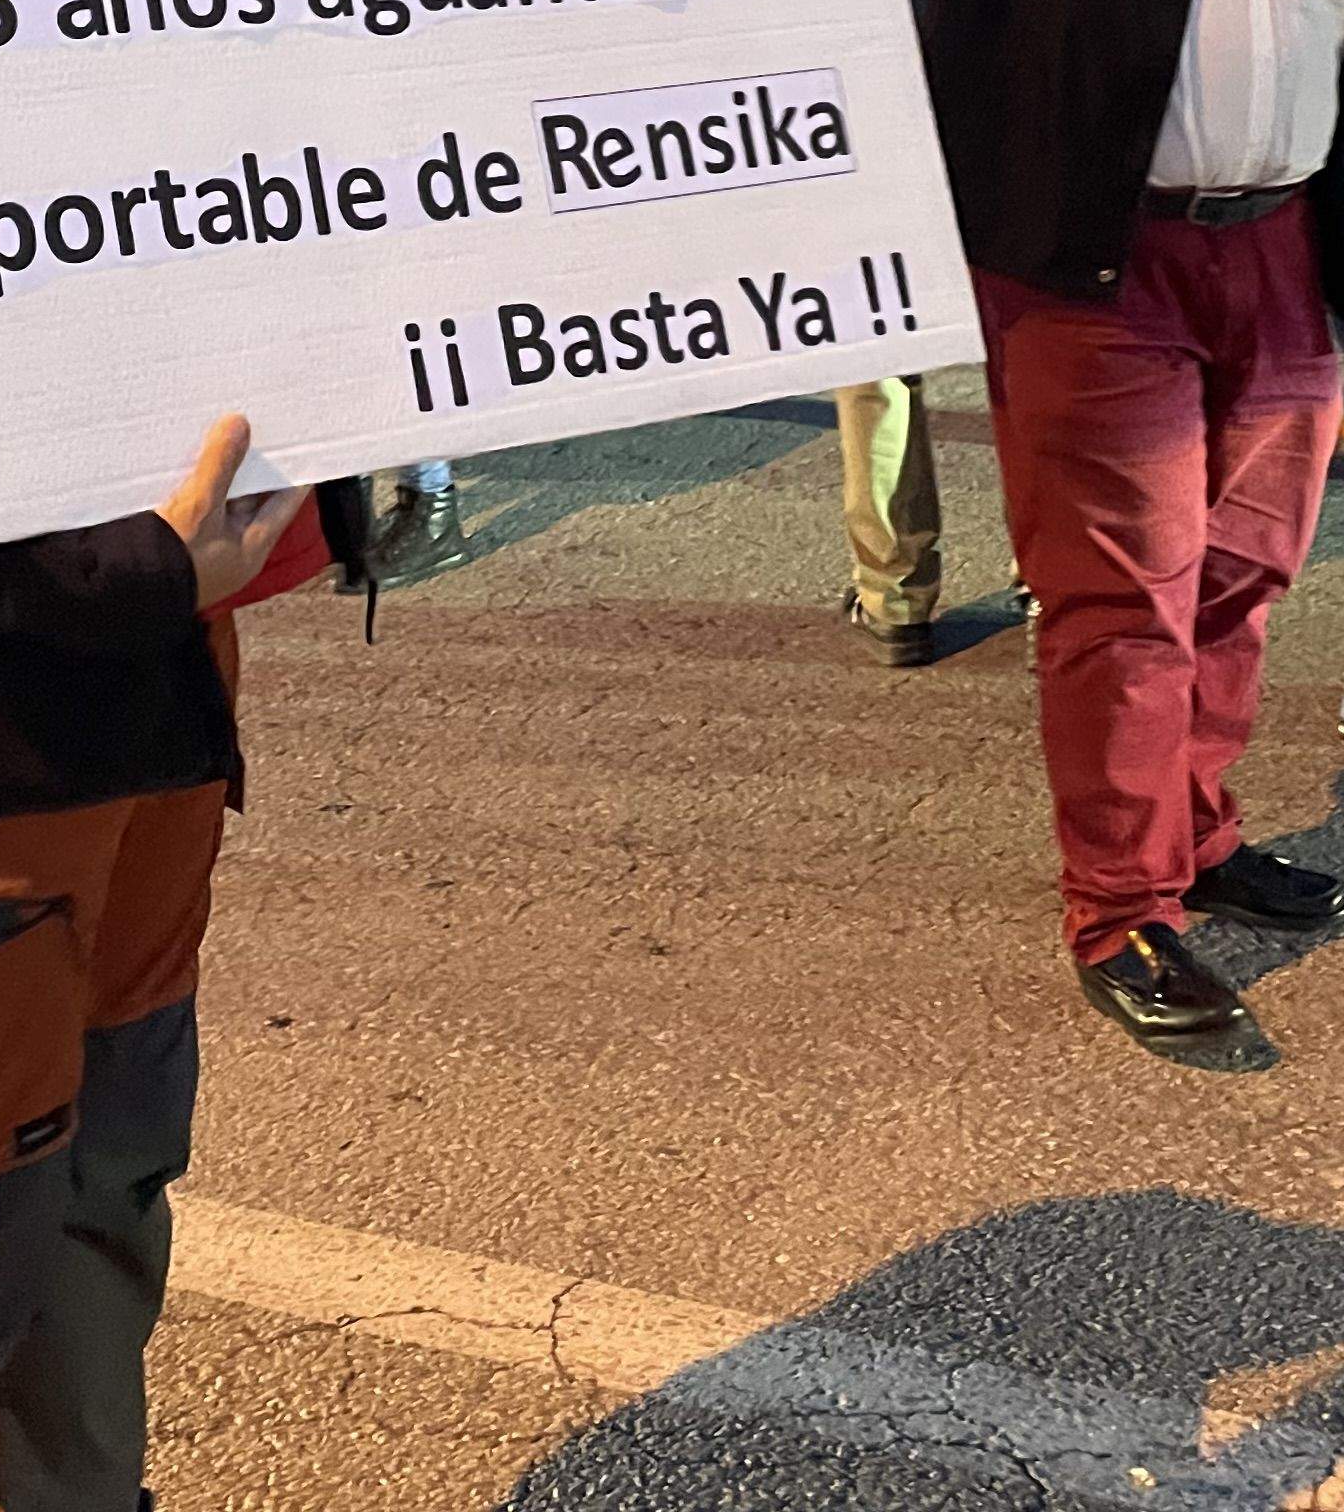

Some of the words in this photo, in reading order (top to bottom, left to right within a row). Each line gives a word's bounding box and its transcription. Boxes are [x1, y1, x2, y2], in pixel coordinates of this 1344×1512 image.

[418, 132, 521, 221] de
[541, 86, 849, 194] Rensika
[498, 292, 729, 385] Basta
[739, 273, 835, 351] Ya
[860, 253, 916, 335] !!
